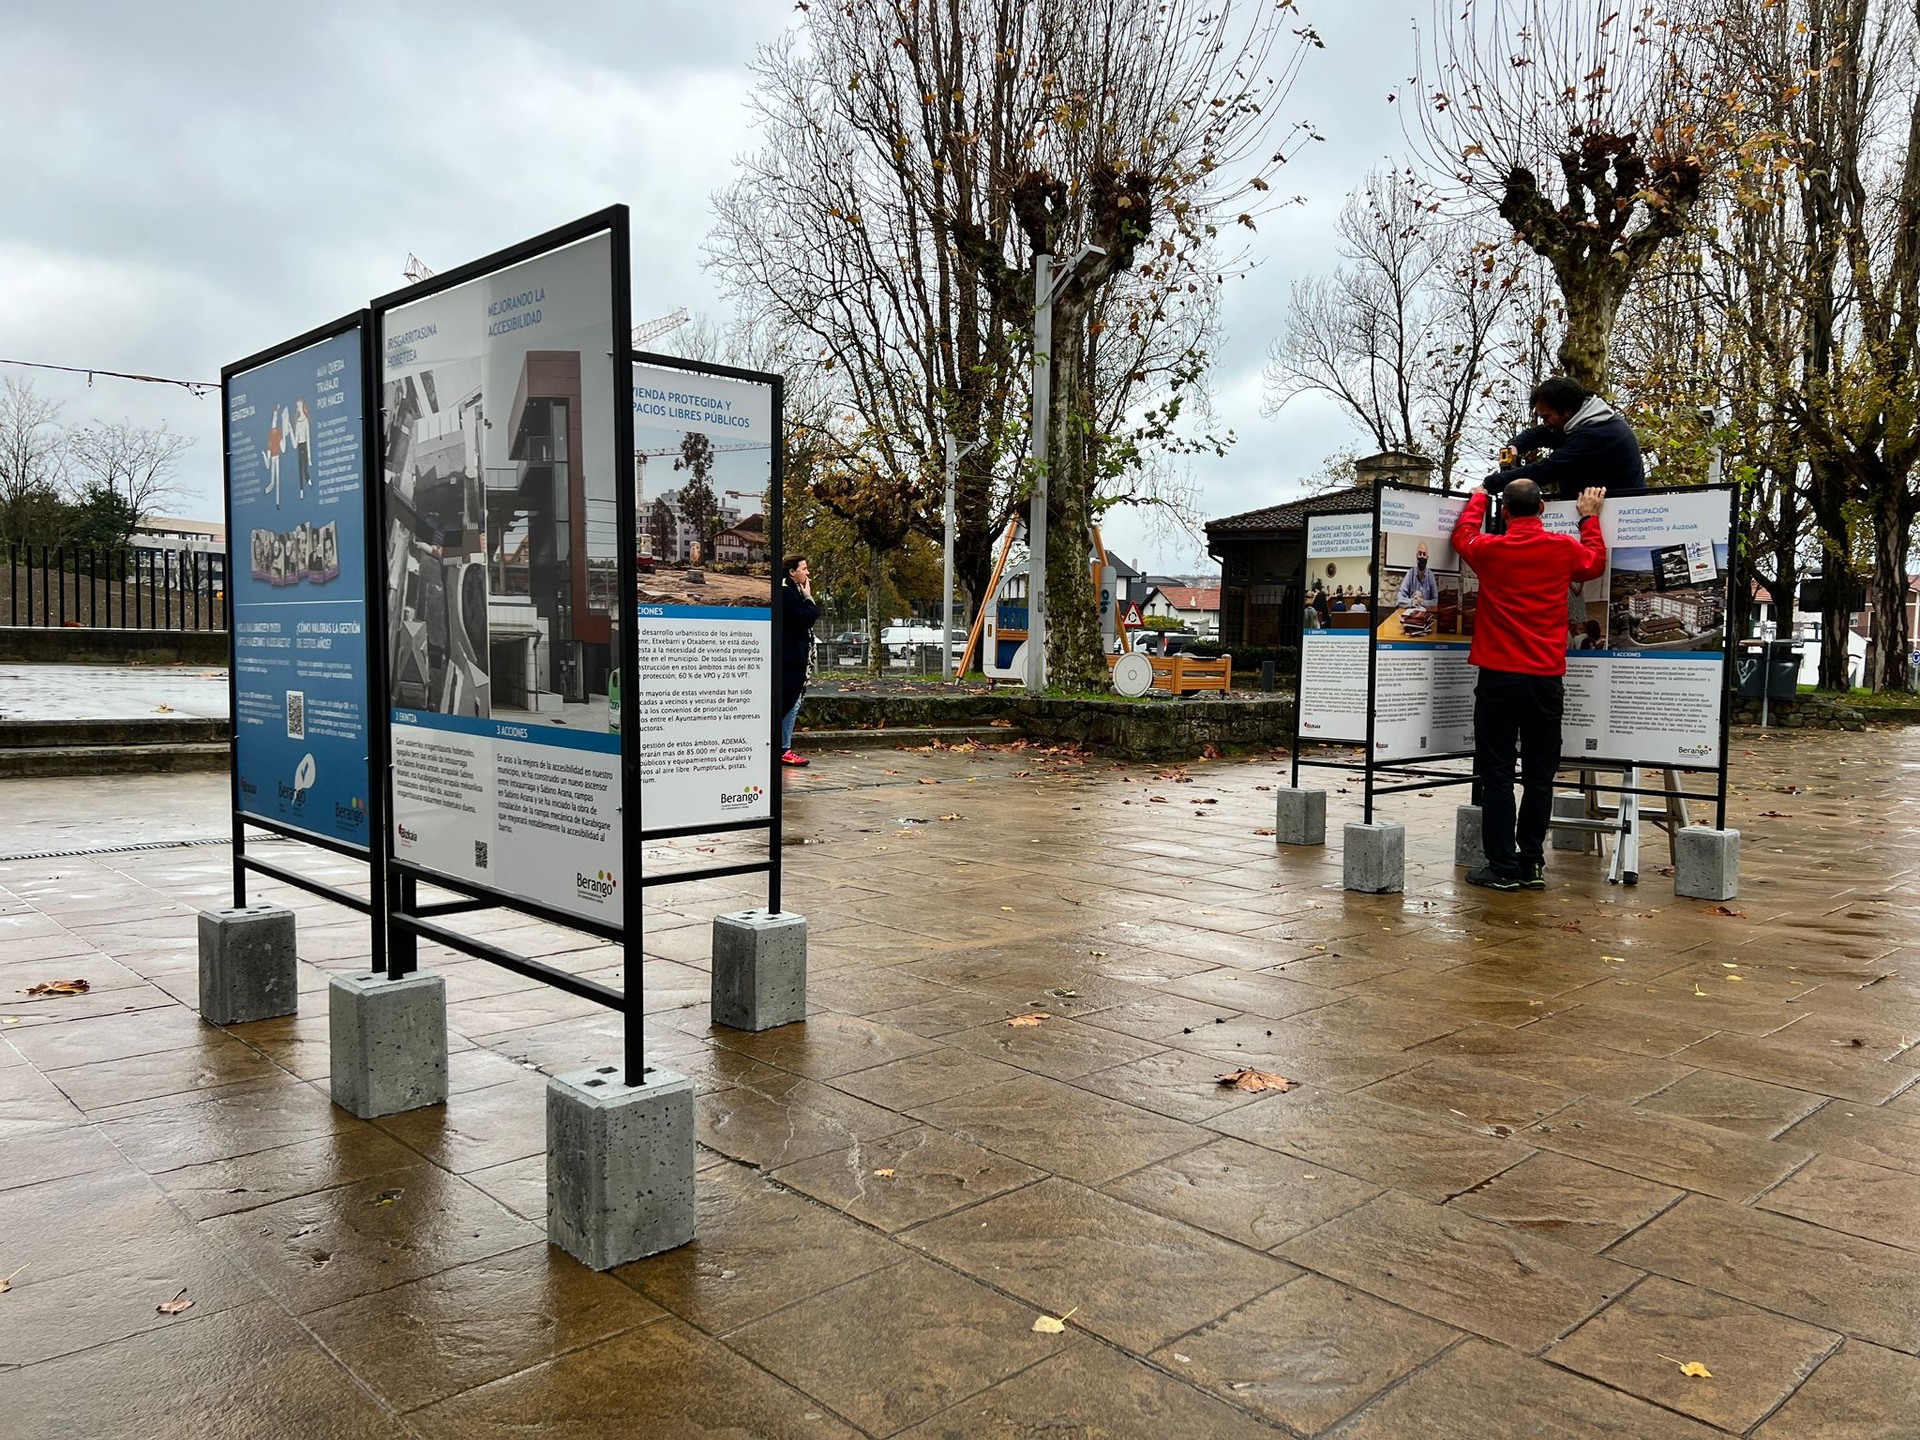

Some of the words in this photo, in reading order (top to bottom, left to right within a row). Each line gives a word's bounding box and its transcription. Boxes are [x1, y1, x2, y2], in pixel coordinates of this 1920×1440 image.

[488, 291, 533, 316] MEJORANDO
[535, 287, 546, 303] LA
[488, 309, 542, 338] ACCESIBILIDAD
[388, 324, 437, 350] IRISGARRITASUNA
[634, 387, 662, 401] IENDA
[669, 392, 714, 407] PROTEGIDA
[725, 401, 732, 411] Y
[669, 407, 702, 421] LIBRES
[697, 409, 750, 428] PÚBLICOS
[1618, 525, 1664, 533] participativos
[703, 705, 738, 714] priorización
[675, 715, 717, 723] Ayuntamiento
[497, 725, 500, 735] 3
[501, 726, 528, 739] ACCIONES
[1678, 746, 1708, 756] Berango
[673, 757, 717, 765] equipamientos
[552, 764, 584, 776] accesibilidad
[592, 770, 613, 780] nuestro
[568, 779, 584, 788] nuevo
[585, 782, 608, 792] ascensor
[574, 792, 594, 802] rampas
[721, 793, 759, 804] Berango
[567, 828, 599, 841] accesibilidad
[577, 873, 613, 898] Berango
